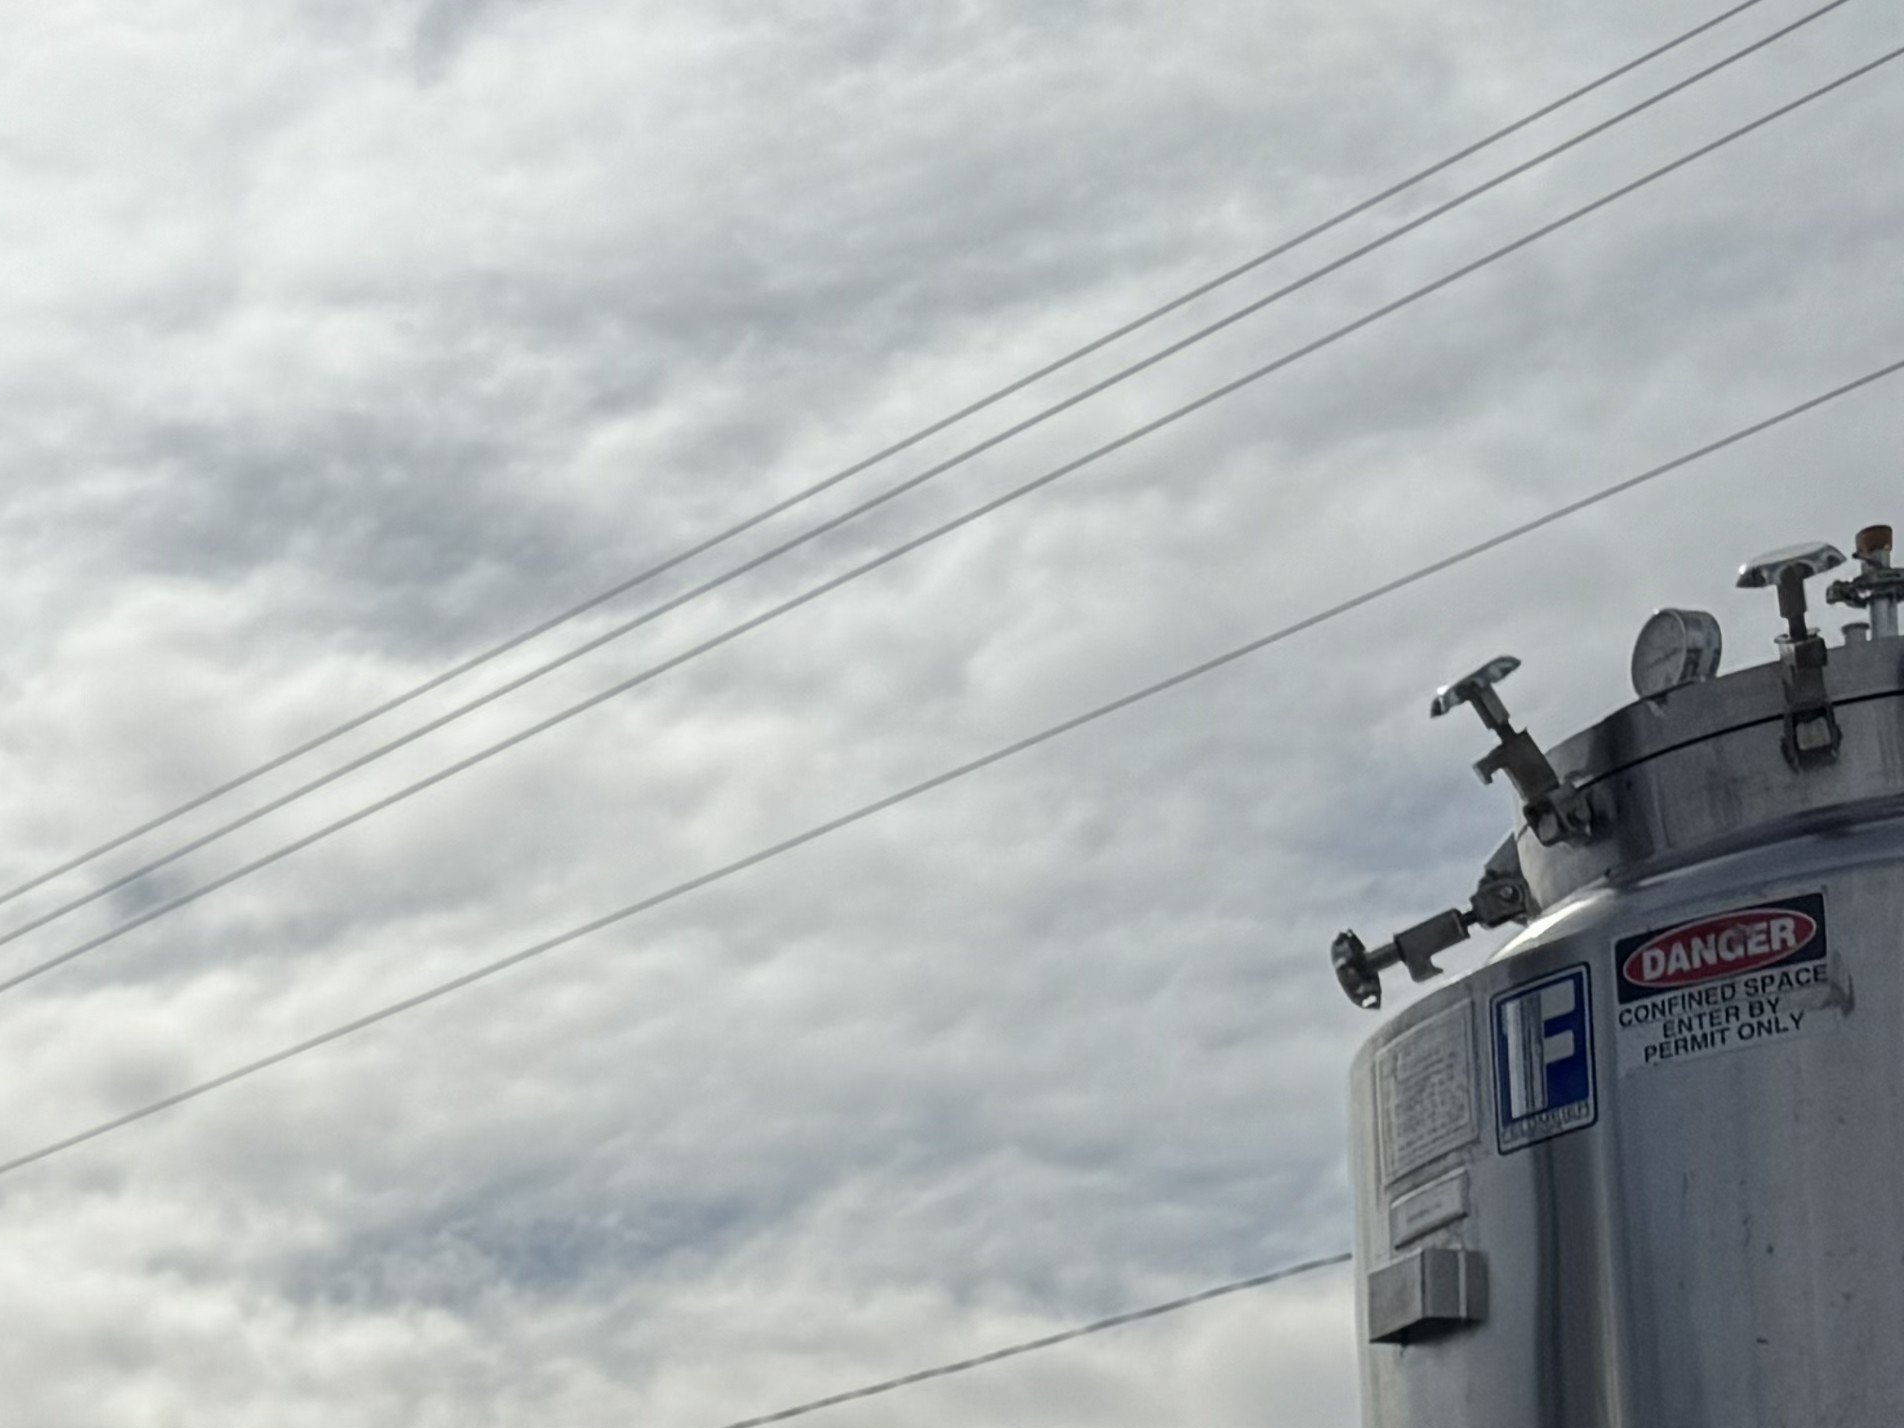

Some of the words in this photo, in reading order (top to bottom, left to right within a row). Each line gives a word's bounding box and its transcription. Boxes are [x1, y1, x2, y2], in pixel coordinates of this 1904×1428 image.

[1641, 915, 1797, 982] DANGER
[1618, 982, 1737, 1028] CONFINED
[1744, 964, 1828, 999] SPACE
[1663, 1005, 1741, 1038] ENTER
[1748, 996, 1782, 1022] BY
[1644, 1029, 1730, 1063] PERMIT
[1739, 1011, 1806, 1043] ONLY
